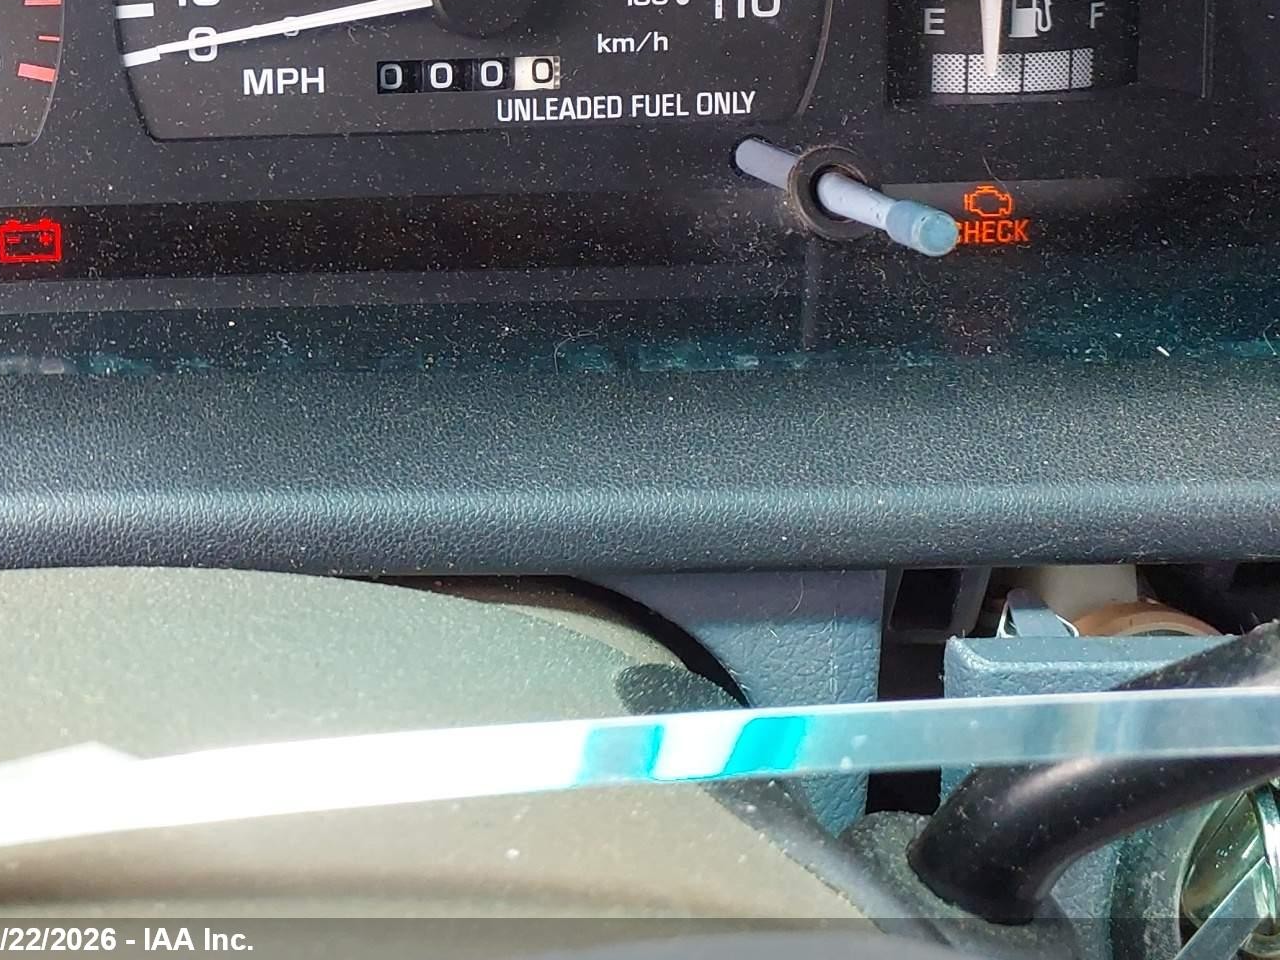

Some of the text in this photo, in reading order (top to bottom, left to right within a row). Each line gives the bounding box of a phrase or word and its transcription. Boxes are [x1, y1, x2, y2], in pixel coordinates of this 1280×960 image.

[925, 8, 945, 34] E
[1090, 2, 1104, 28] F
[188, 27, 218, 62] 0
[598, 32, 668, 53] km/h
[243, 67, 325, 95] MPH
[496, 91, 756, 122] UNLEADED FUEL ONLY
